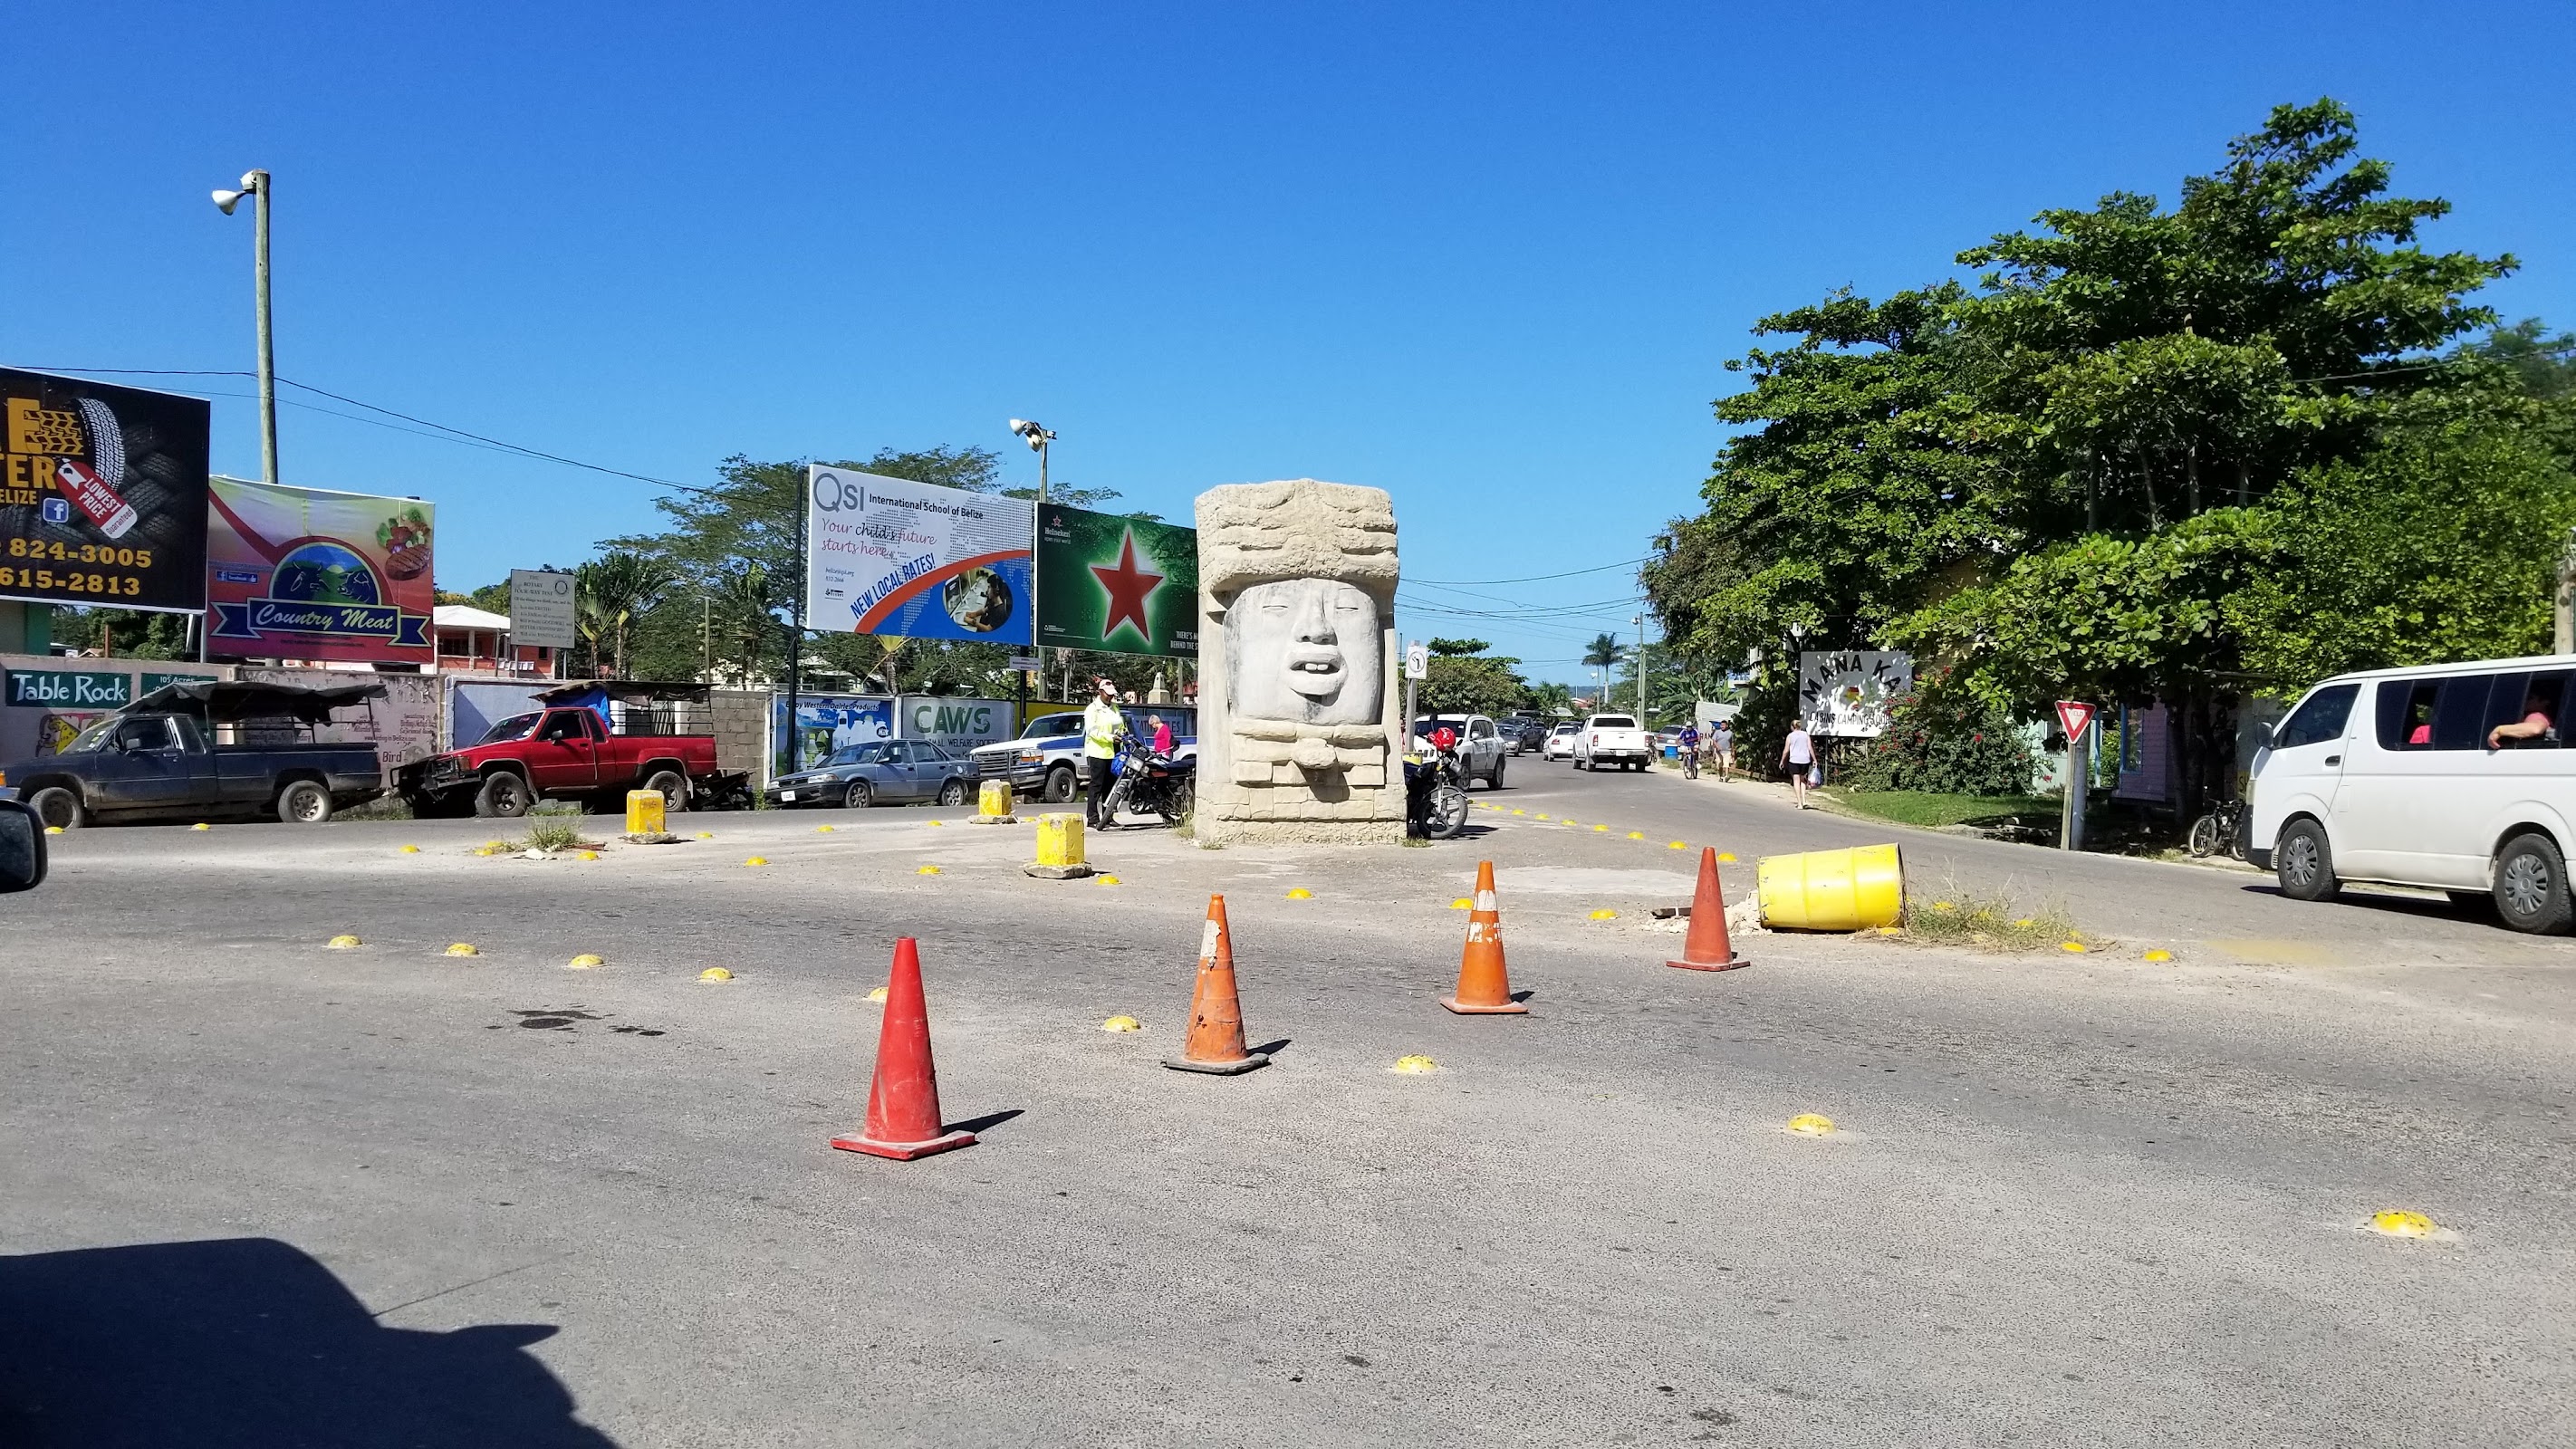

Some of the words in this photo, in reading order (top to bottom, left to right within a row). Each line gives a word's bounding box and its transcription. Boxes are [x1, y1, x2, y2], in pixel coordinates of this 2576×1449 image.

[0, 453, 57, 490] ER
[78, 492, 108, 519] PRICE
[83, 477, 122, 513] LOWEST
[813, 473, 864, 513] QSI
[869, 493, 923, 511] International
[923, 502, 950, 515] School
[951, 504, 960, 515] of
[961, 507, 984, 520] Belize
[106, 509, 133, 535] Guaranteed
[822, 517, 852, 534] Your
[855, 523, 897, 542] child's
[897, 528, 937, 546] future
[1044, 527, 1071, 538] Heineken
[9, 538, 152, 568] 824-3005
[822, 537, 860, 554] starts
[0, 567, 140, 596] 615-2813
[850, 589, 874, 619] NEW
[872, 570, 904, 601] LOCAL
[902, 552, 937, 583] RATES!
[256, 604, 334, 631] Country
[341, 608, 395, 630] Meat
[1170, 640, 1186, 649] BEHIND
[1176, 630, 1193, 639] THERE'S
[12, 674, 70, 702] Table
[74, 675, 127, 704] Rock
[1802, 654, 1863, 704] MANA
[1872, 658, 1901, 693] KA
[786, 701, 803, 710] Eoy
[804, 701, 831, 709] Western
[1810, 711, 1836, 724] CABINS
[1837, 712, 1870, 725] CAMPING
[913, 705, 991, 734] CAWS
[948, 738, 973, 747] WELFARE
[383, 751, 402, 763] Bird
